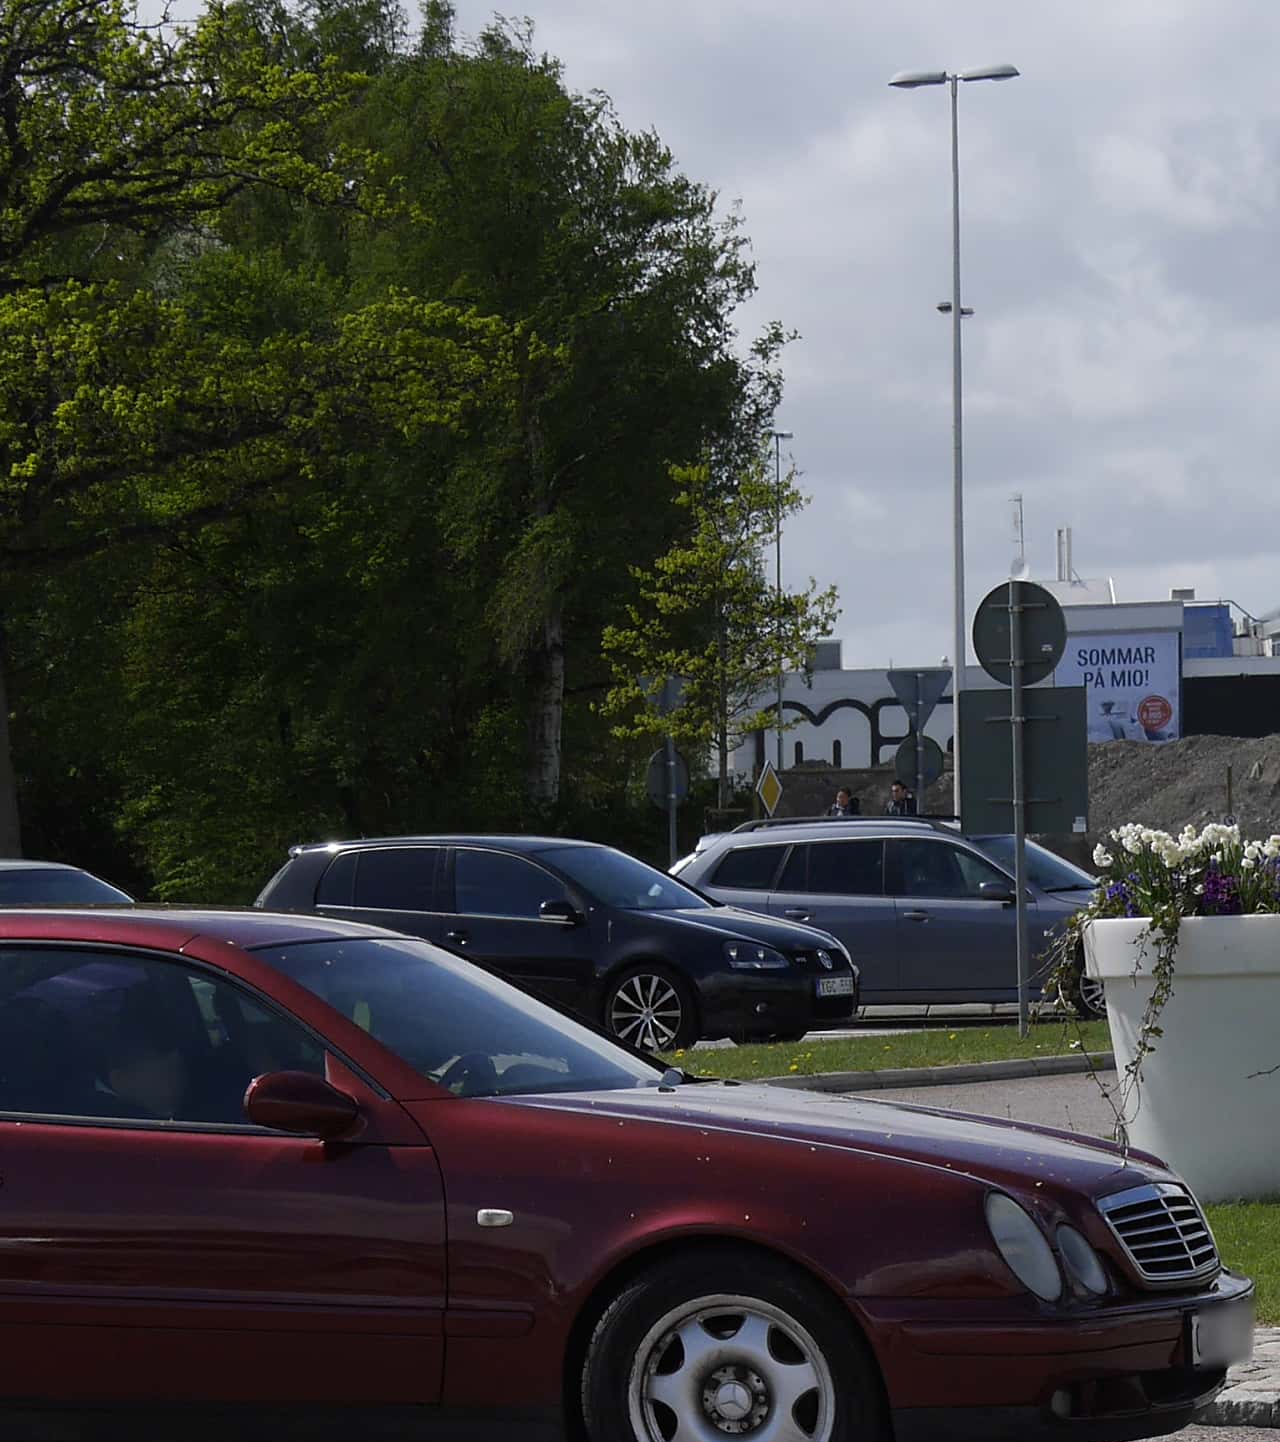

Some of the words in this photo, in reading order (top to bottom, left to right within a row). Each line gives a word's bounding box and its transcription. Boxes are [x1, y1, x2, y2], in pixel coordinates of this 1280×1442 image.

[1077, 646, 1156, 667] SOMMAR
[1083, 667, 1105, 689] PÅ
[1111, 669, 1149, 688] MIO!
